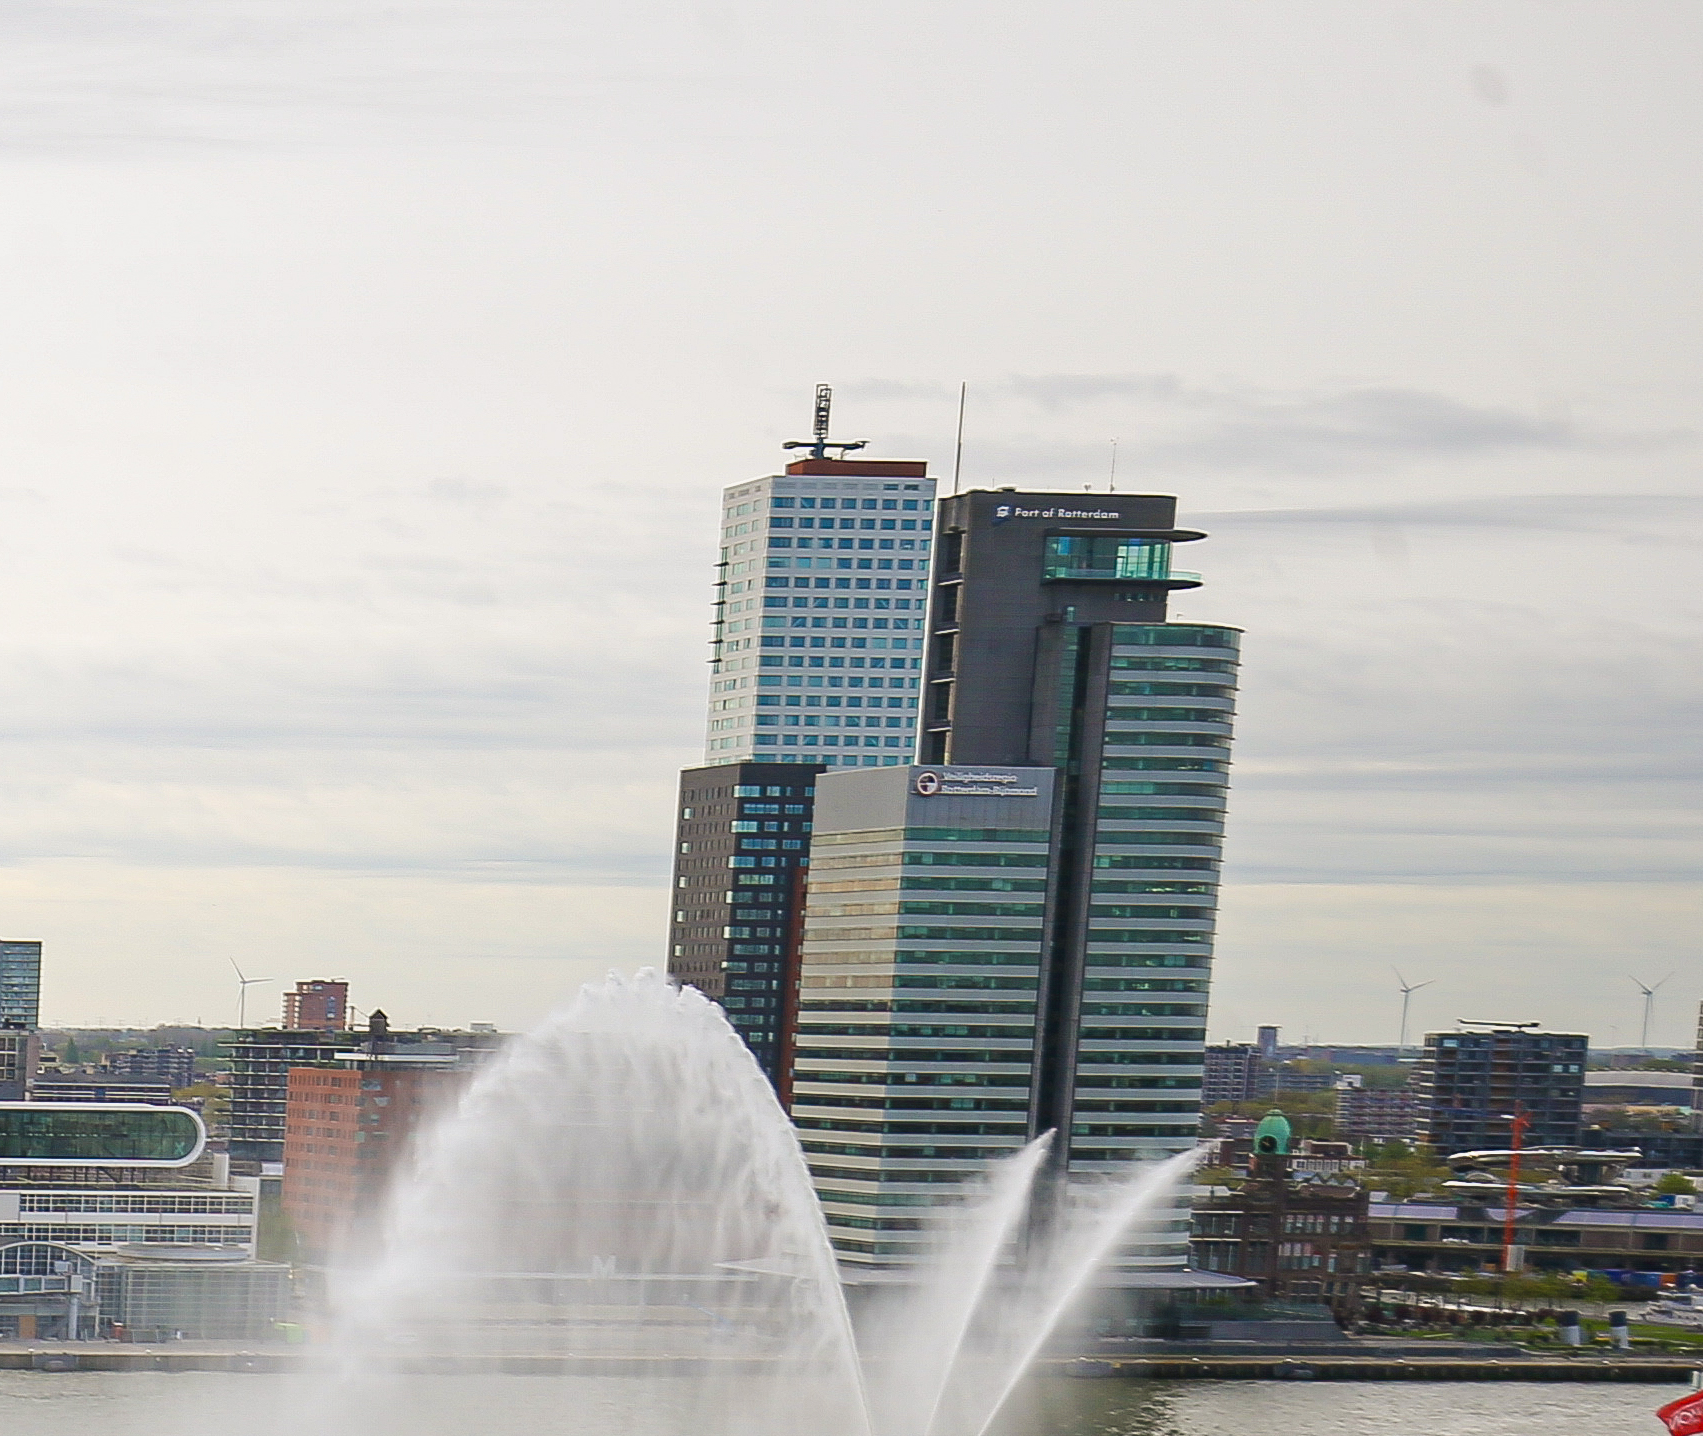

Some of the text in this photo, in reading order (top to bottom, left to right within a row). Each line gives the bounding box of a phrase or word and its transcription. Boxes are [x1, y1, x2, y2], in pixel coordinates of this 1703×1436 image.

[1015, 507, 1119, 519] Port of Rotterdam
